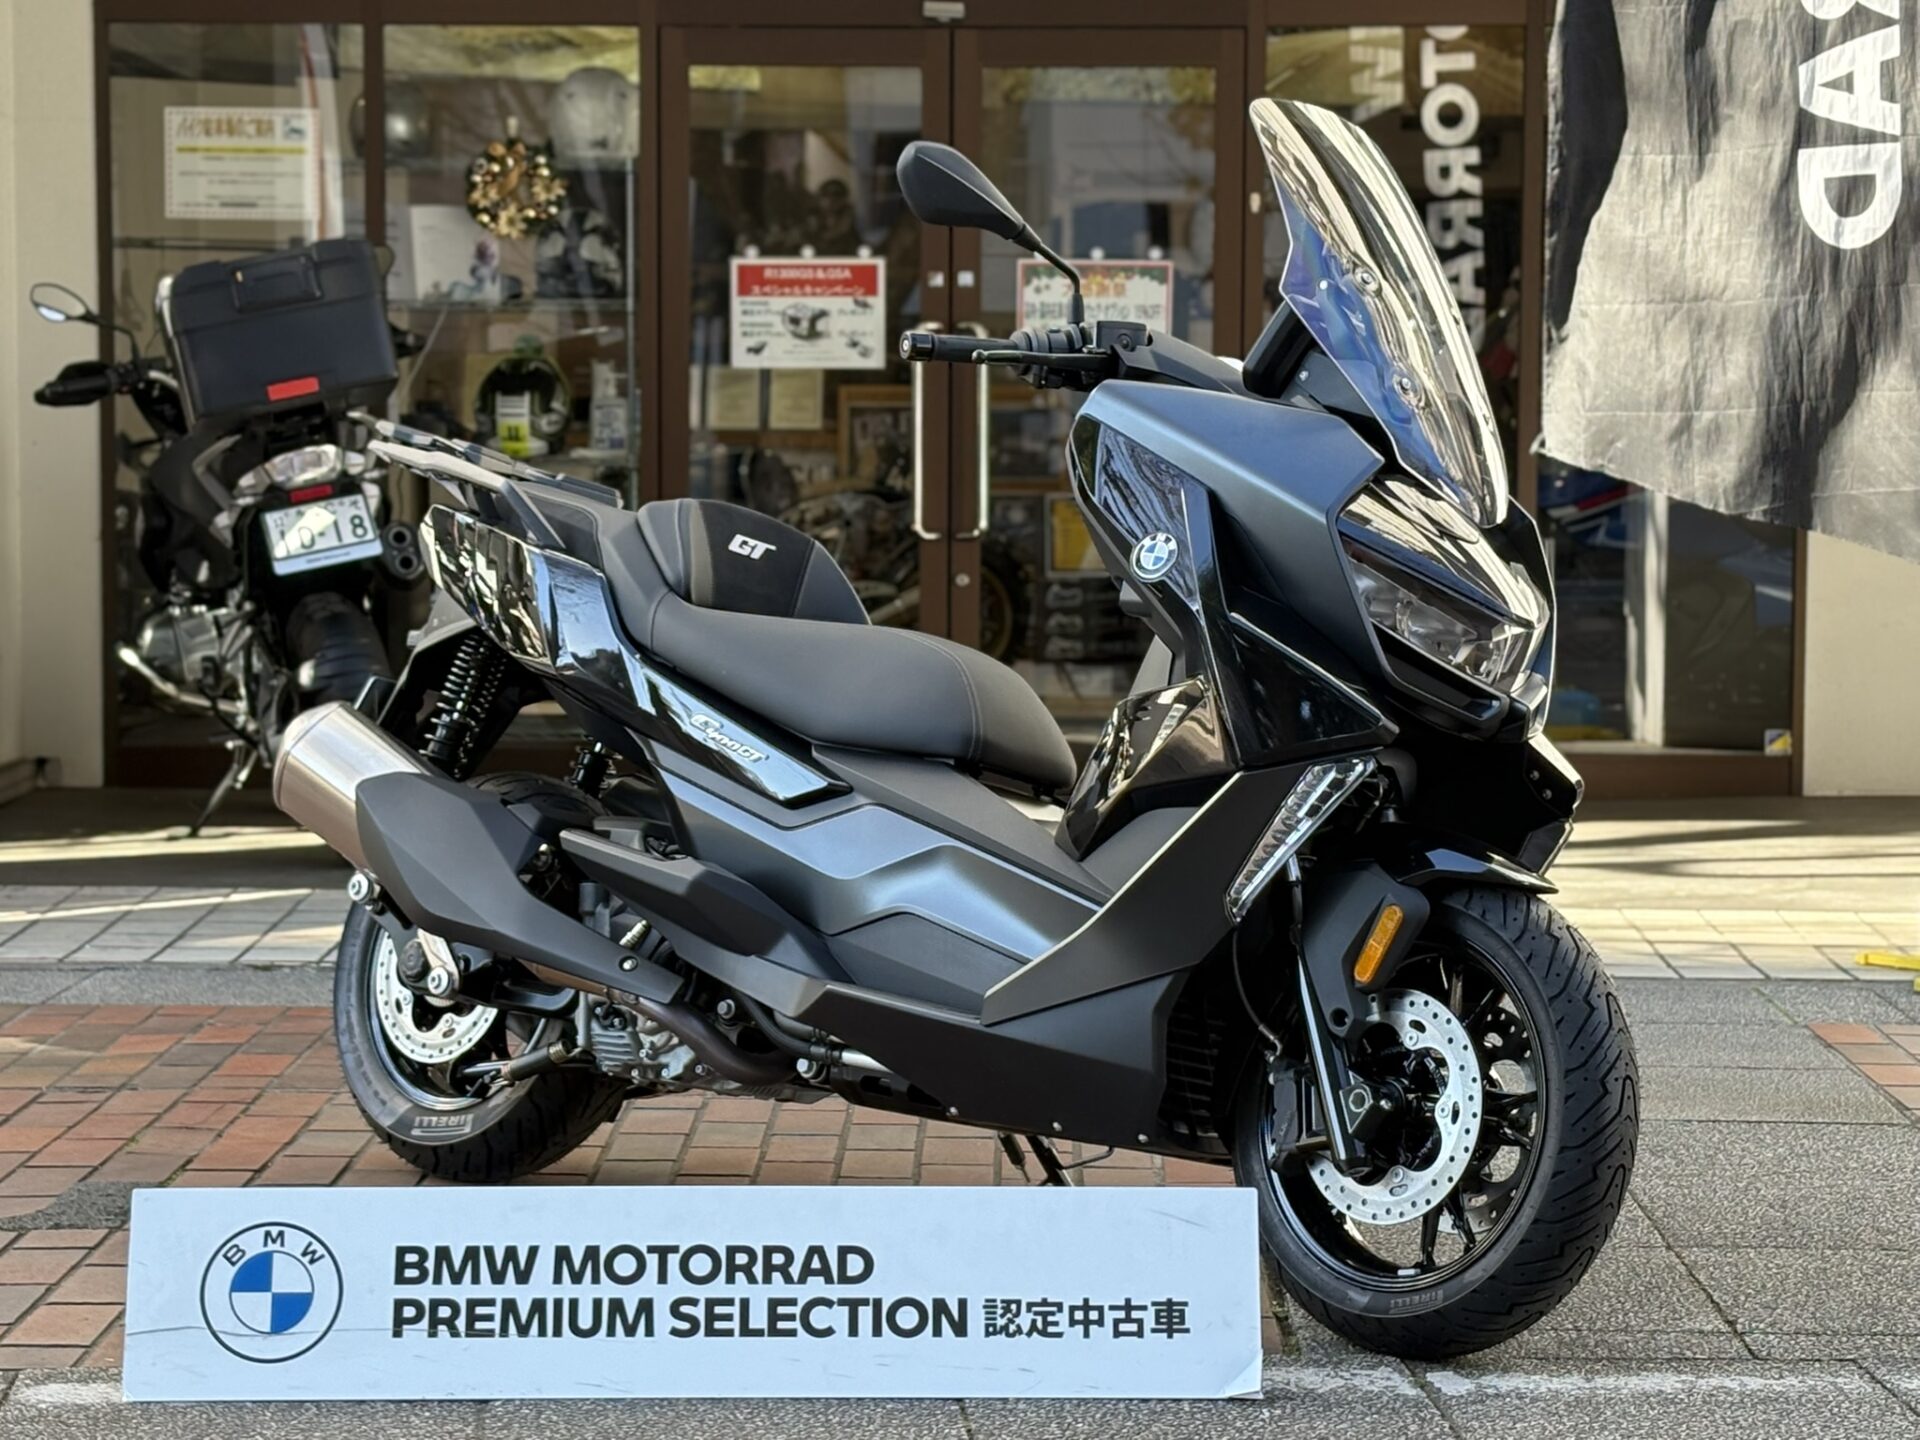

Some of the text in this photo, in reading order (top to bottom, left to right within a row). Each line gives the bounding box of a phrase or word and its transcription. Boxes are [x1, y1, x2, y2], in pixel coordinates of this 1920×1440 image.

[728, 533, 777, 560] GT
[411, 1114, 474, 1136] PIRELLI
[222, 1229, 326, 1267] BMW
[394, 1244, 875, 1285] BMW MOTORRAD
[392, 1296, 1191, 1339] PREMIUM SELECTION 認定中古車
